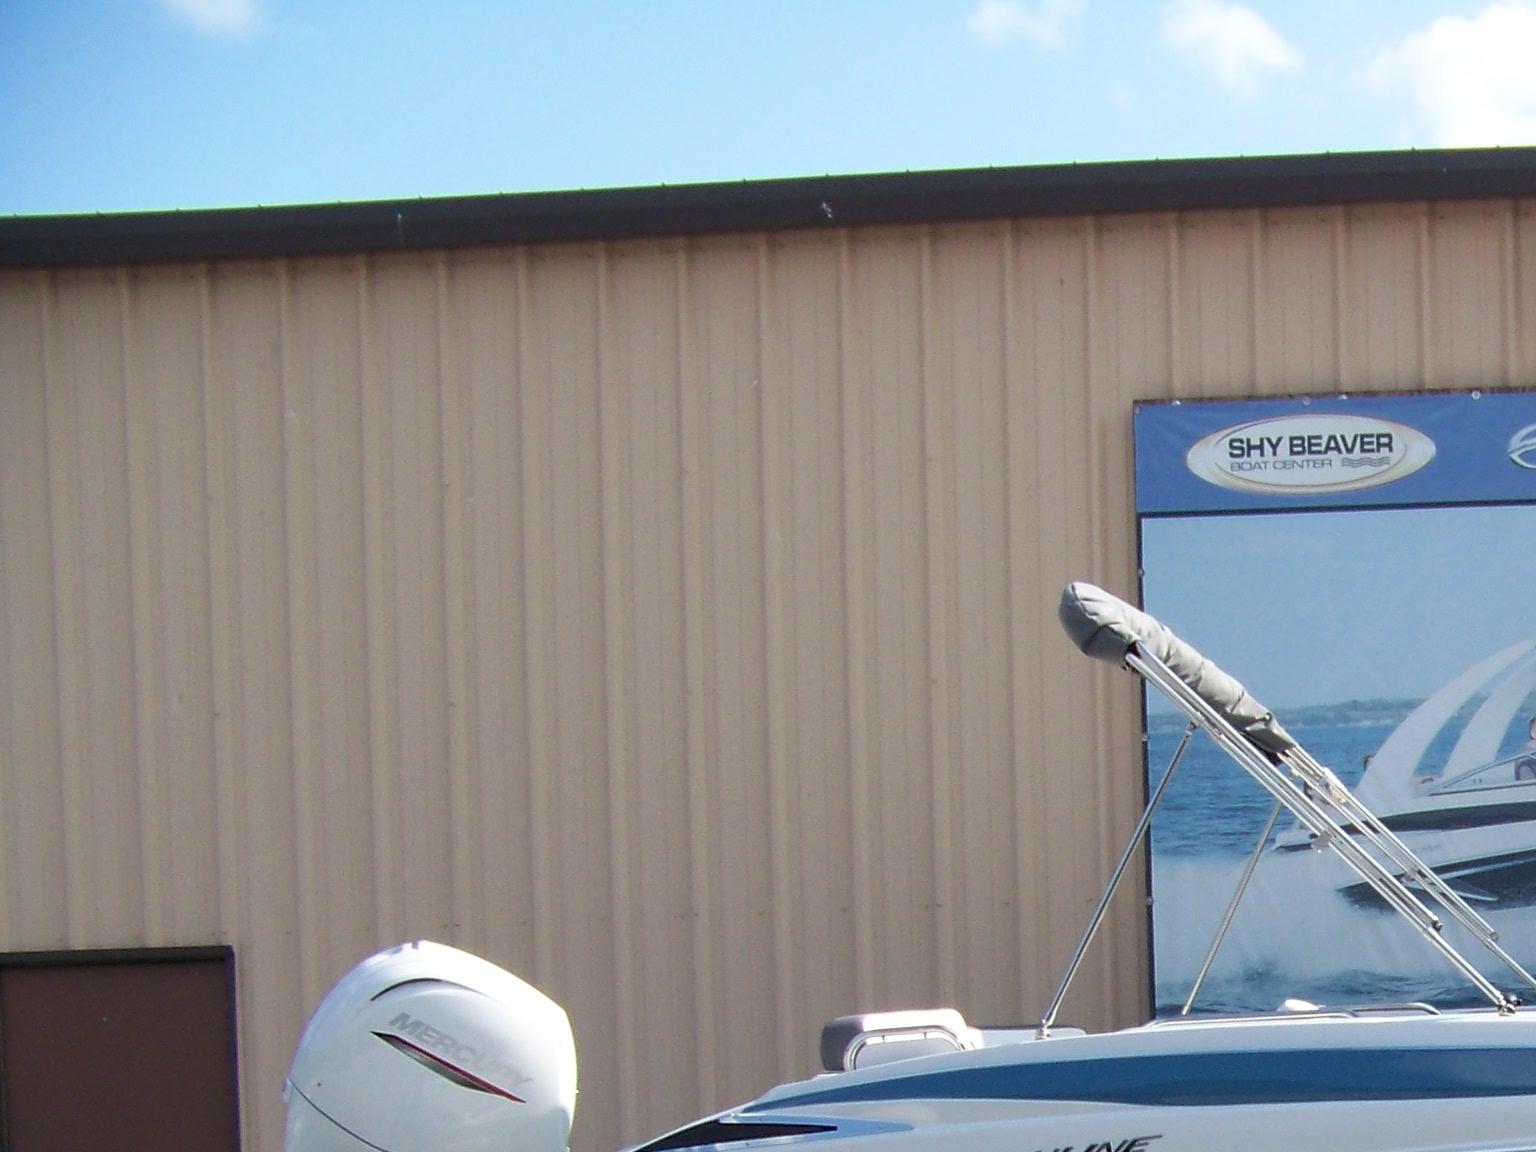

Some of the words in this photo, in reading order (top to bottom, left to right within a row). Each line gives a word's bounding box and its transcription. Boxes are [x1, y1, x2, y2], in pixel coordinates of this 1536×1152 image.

[1229, 436, 1283, 458] SHY
[1289, 433, 1393, 455] BEAVER
[1230, 462, 1269, 472] BOAT
[1273, 459, 1332, 471] CENTER
